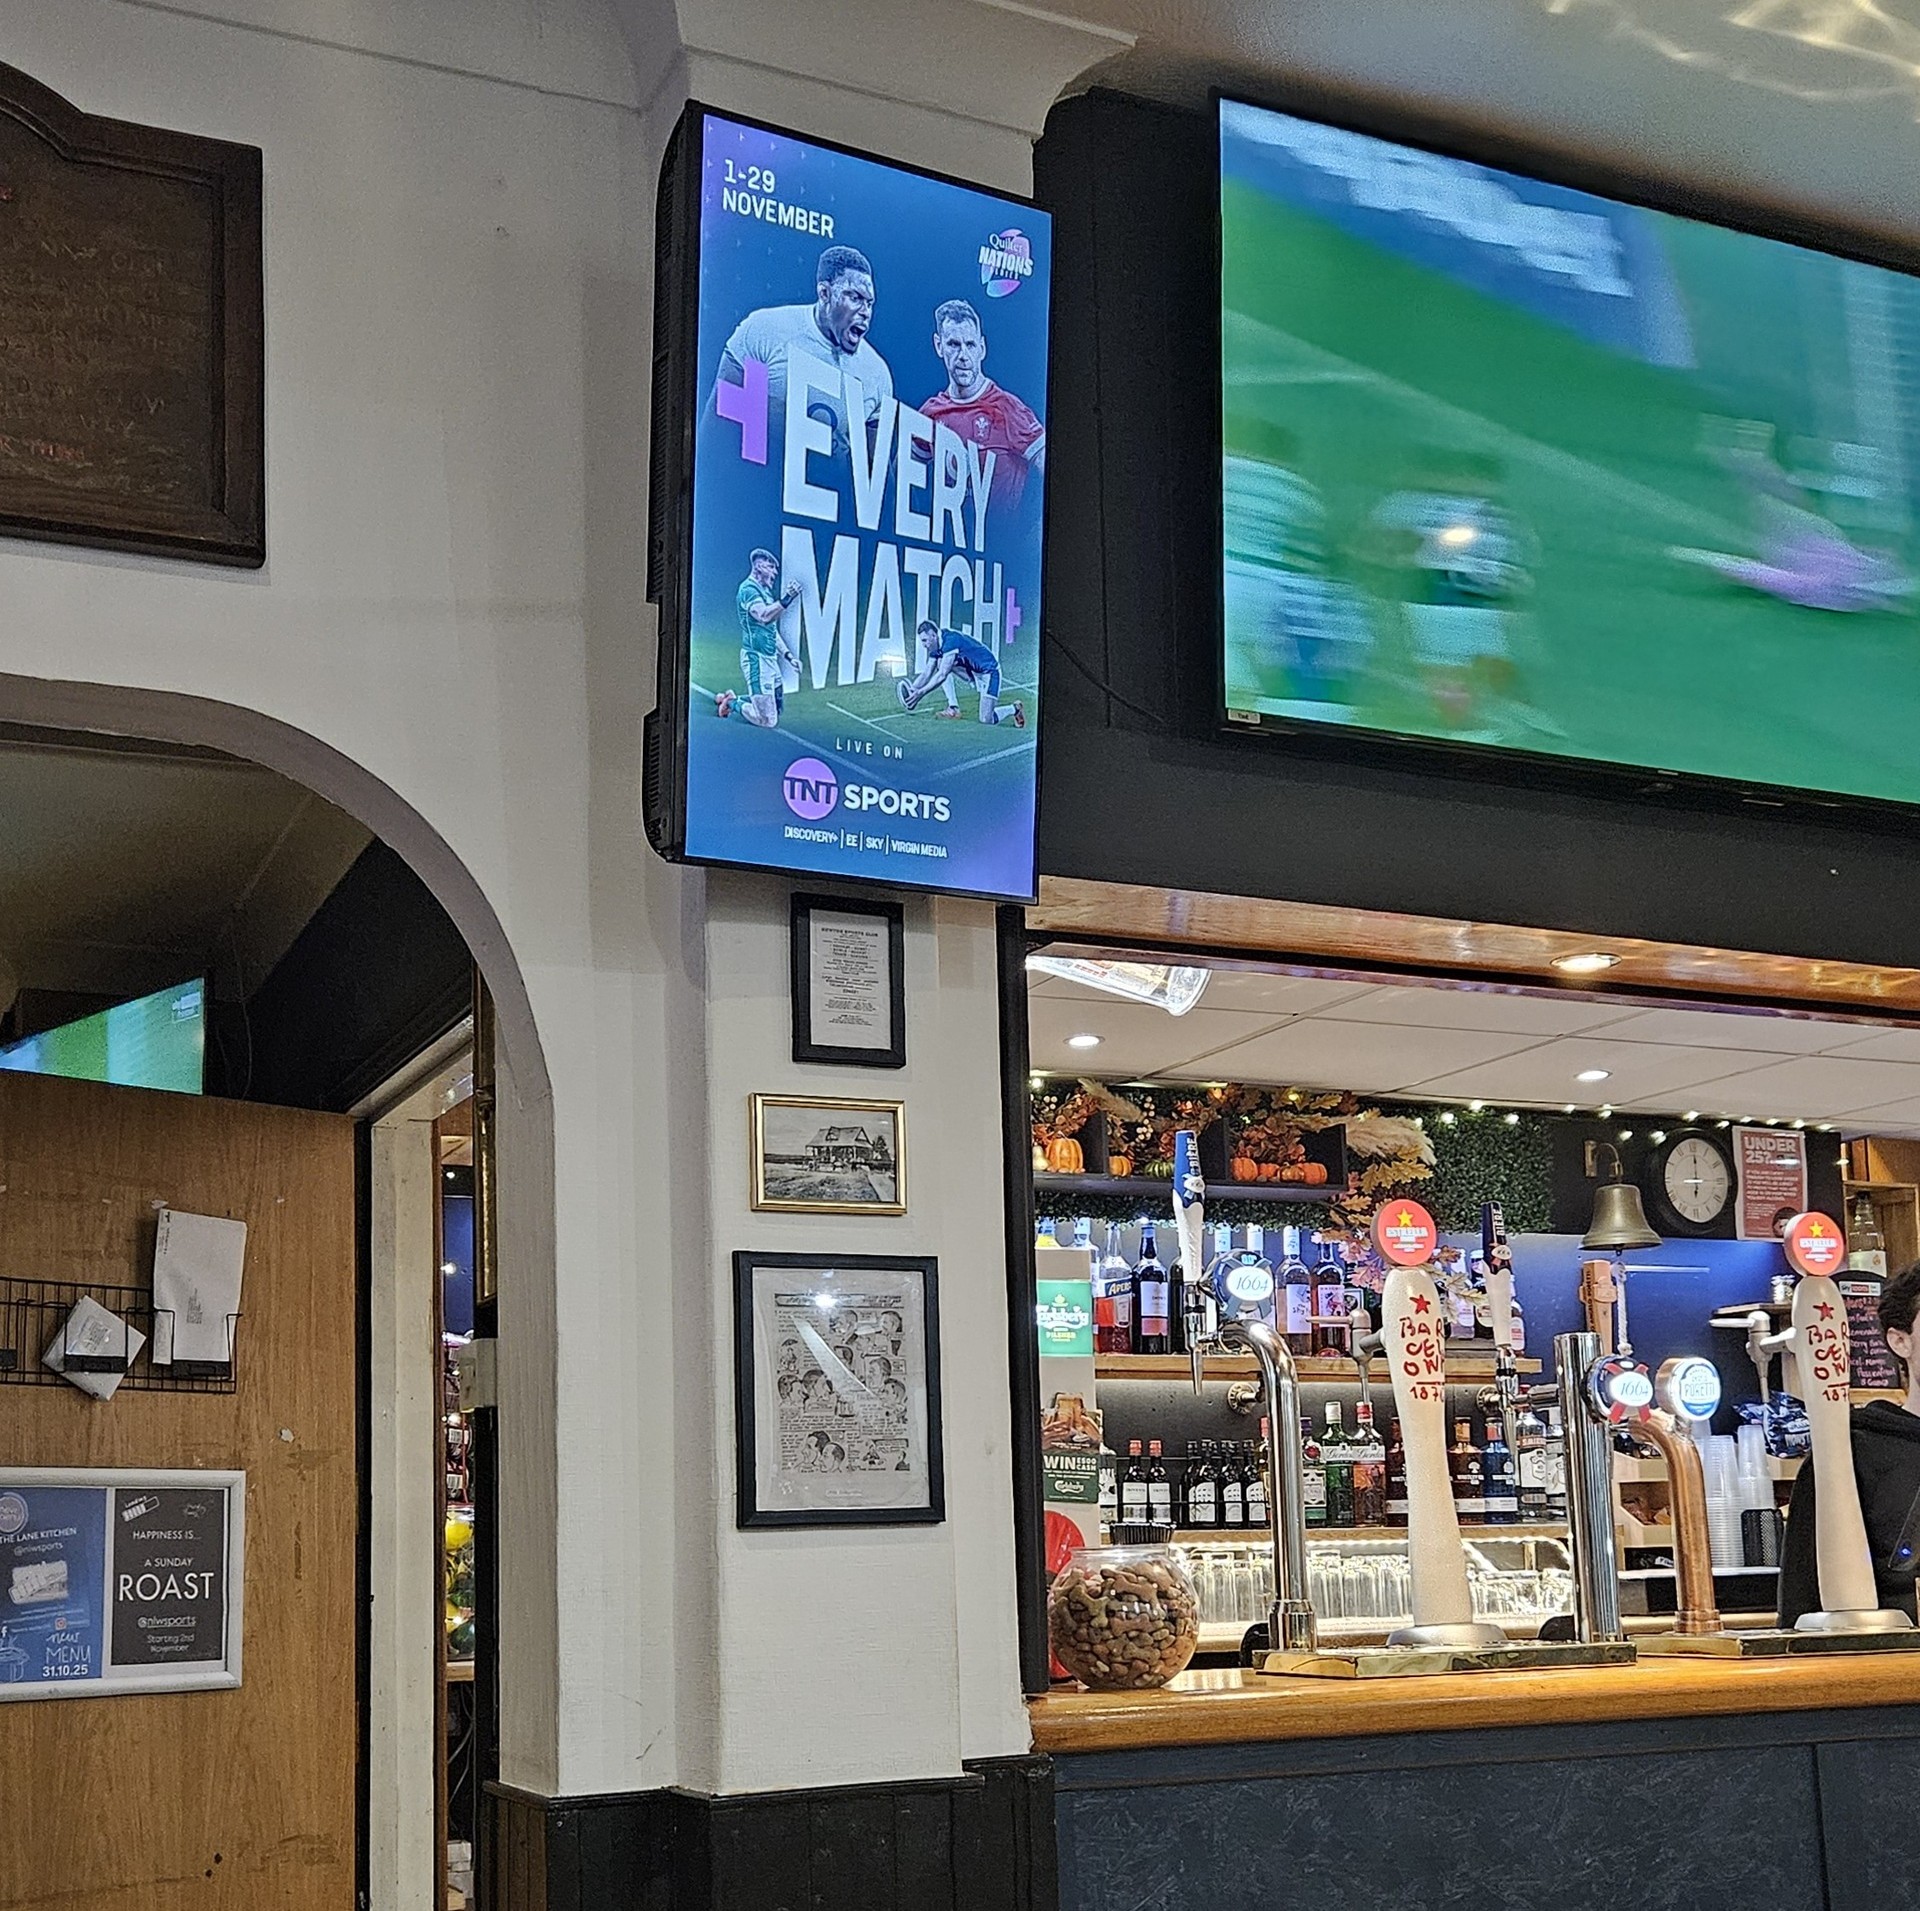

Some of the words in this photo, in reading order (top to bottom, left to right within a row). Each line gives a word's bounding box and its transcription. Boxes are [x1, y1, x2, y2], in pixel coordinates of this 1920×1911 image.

[723, 159, 776, 194] 1-29
[722, 187, 835, 239] NOVEMBER
[978, 246, 1034, 276] NATIONS
[783, 351, 997, 553] EVERY
[781, 525, 1002, 694] MATCH
[836, 737, 873, 755] LIVE
[883, 745, 903, 760] ON
[783, 776, 839, 804] TNT
[844, 784, 951, 822] SPORTS
[846, 833, 859, 847] EE
[865, 837, 885, 851] SKY
[890, 839, 921, 856] VIRGIN
[920, 845, 948, 859] MEDIA
[1744, 1136, 1797, 1152] UNDER
[1745, 1150, 1772, 1164] 25?
[1235, 1275, 1270, 1291] 1664
[1399, 1316, 1446, 1339] BAR
[1805, 1321, 1850, 1345] BAR
[1620, 1382, 1650, 1396] 1664
[1043, 1455, 1076, 1470] WIN
[0, 1534, 15, 1544] THE
[17, 1531, 40, 1542] LANE
[40, 1527, 77, 1538] KITCHEN
[133, 1530, 183, 1540] HAPPINESS
[144, 1558, 152, 1567] A
[154, 1557, 193, 1568] SUNDAY
[118, 1572, 215, 1601] ROAST
[46, 1632, 80, 1644] new
[147, 1634, 179, 1644] Starting
[180, 1633, 195, 1642] 2nd
[46, 1645, 92, 1664] MENU
[150, 1644, 190, 1653] November
[42, 1664, 89, 1677] 31.10.25
